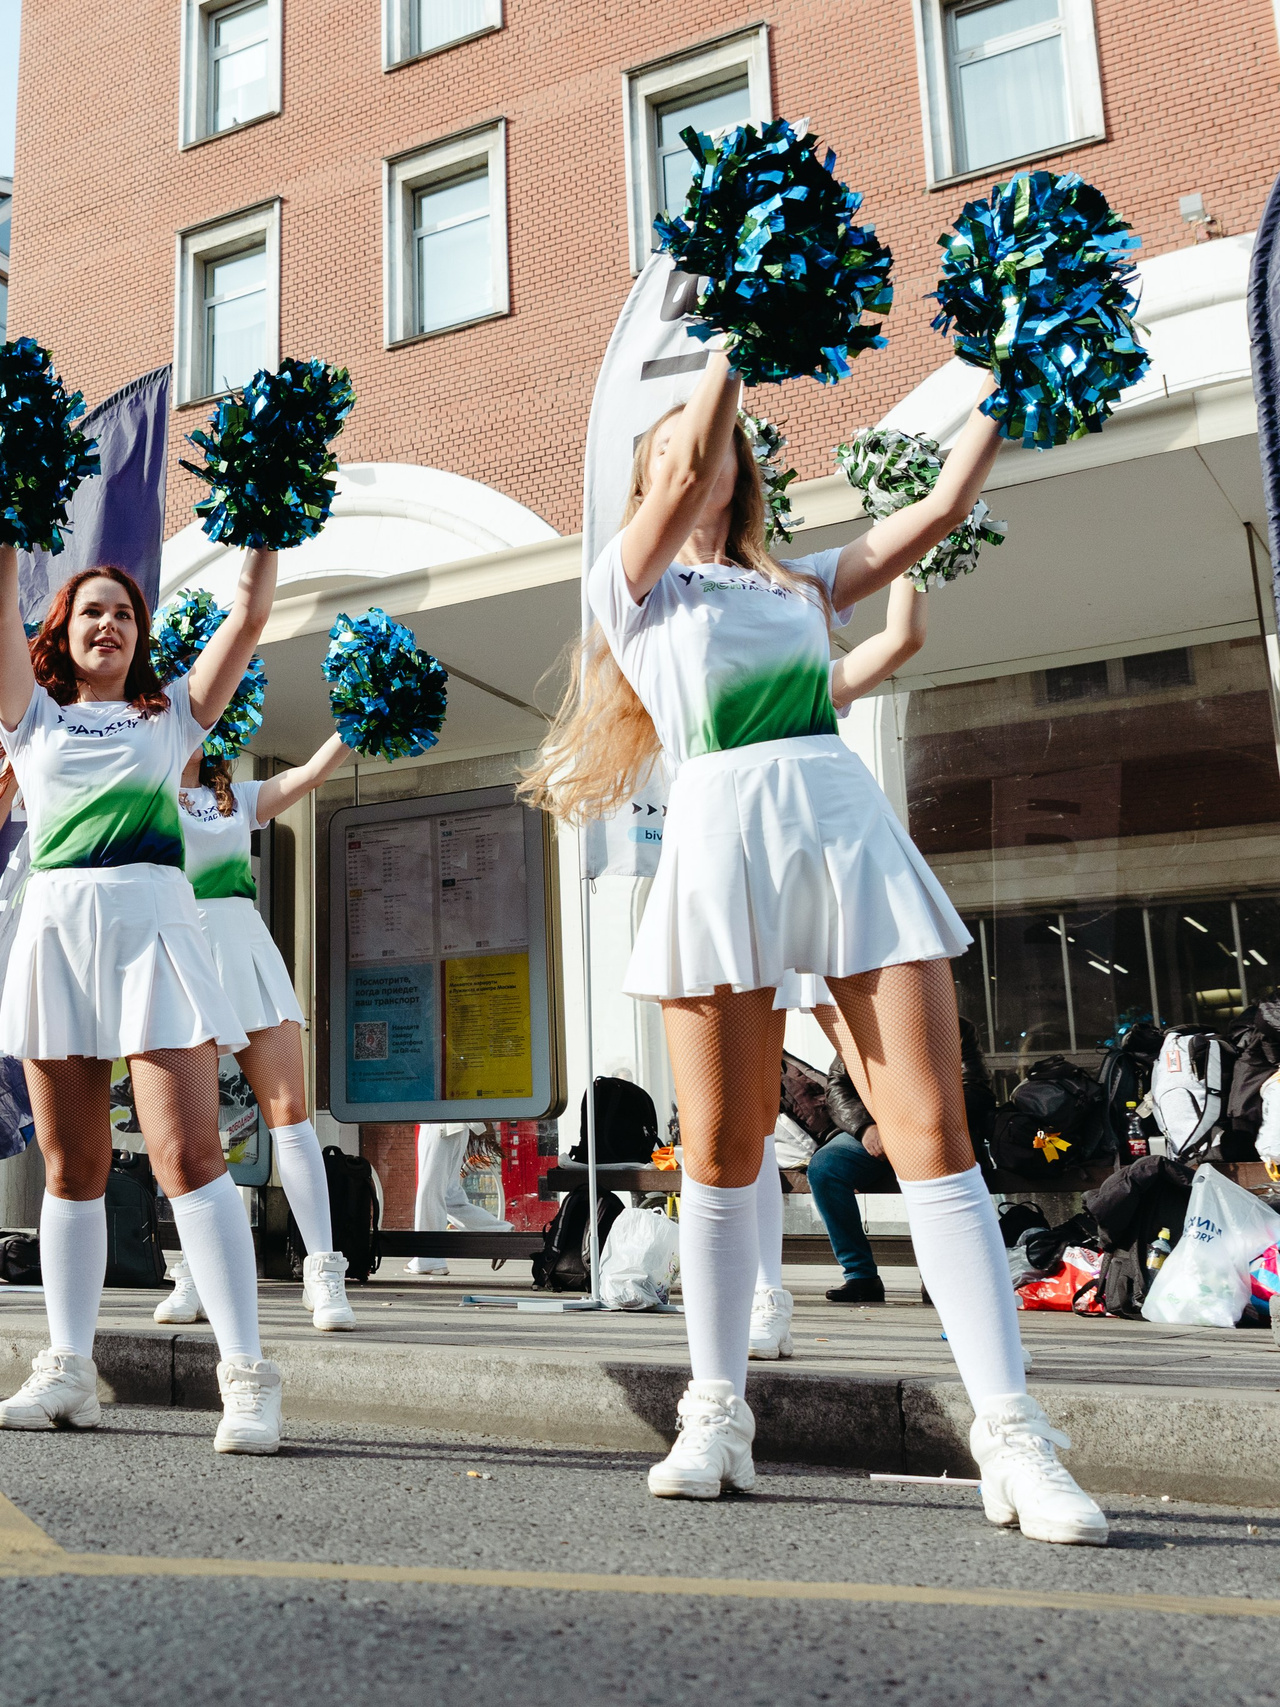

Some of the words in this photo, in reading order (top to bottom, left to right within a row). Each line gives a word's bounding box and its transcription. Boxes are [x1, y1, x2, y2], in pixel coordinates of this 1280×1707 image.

[645, 830, 663, 840] biv
[355, 976, 411, 987] Посмотрите,
[355, 989, 380, 997] когда
[381, 986, 418, 996] приедет
[355, 999, 372, 1007] ваш
[374, 996, 420, 1007] транспорт
